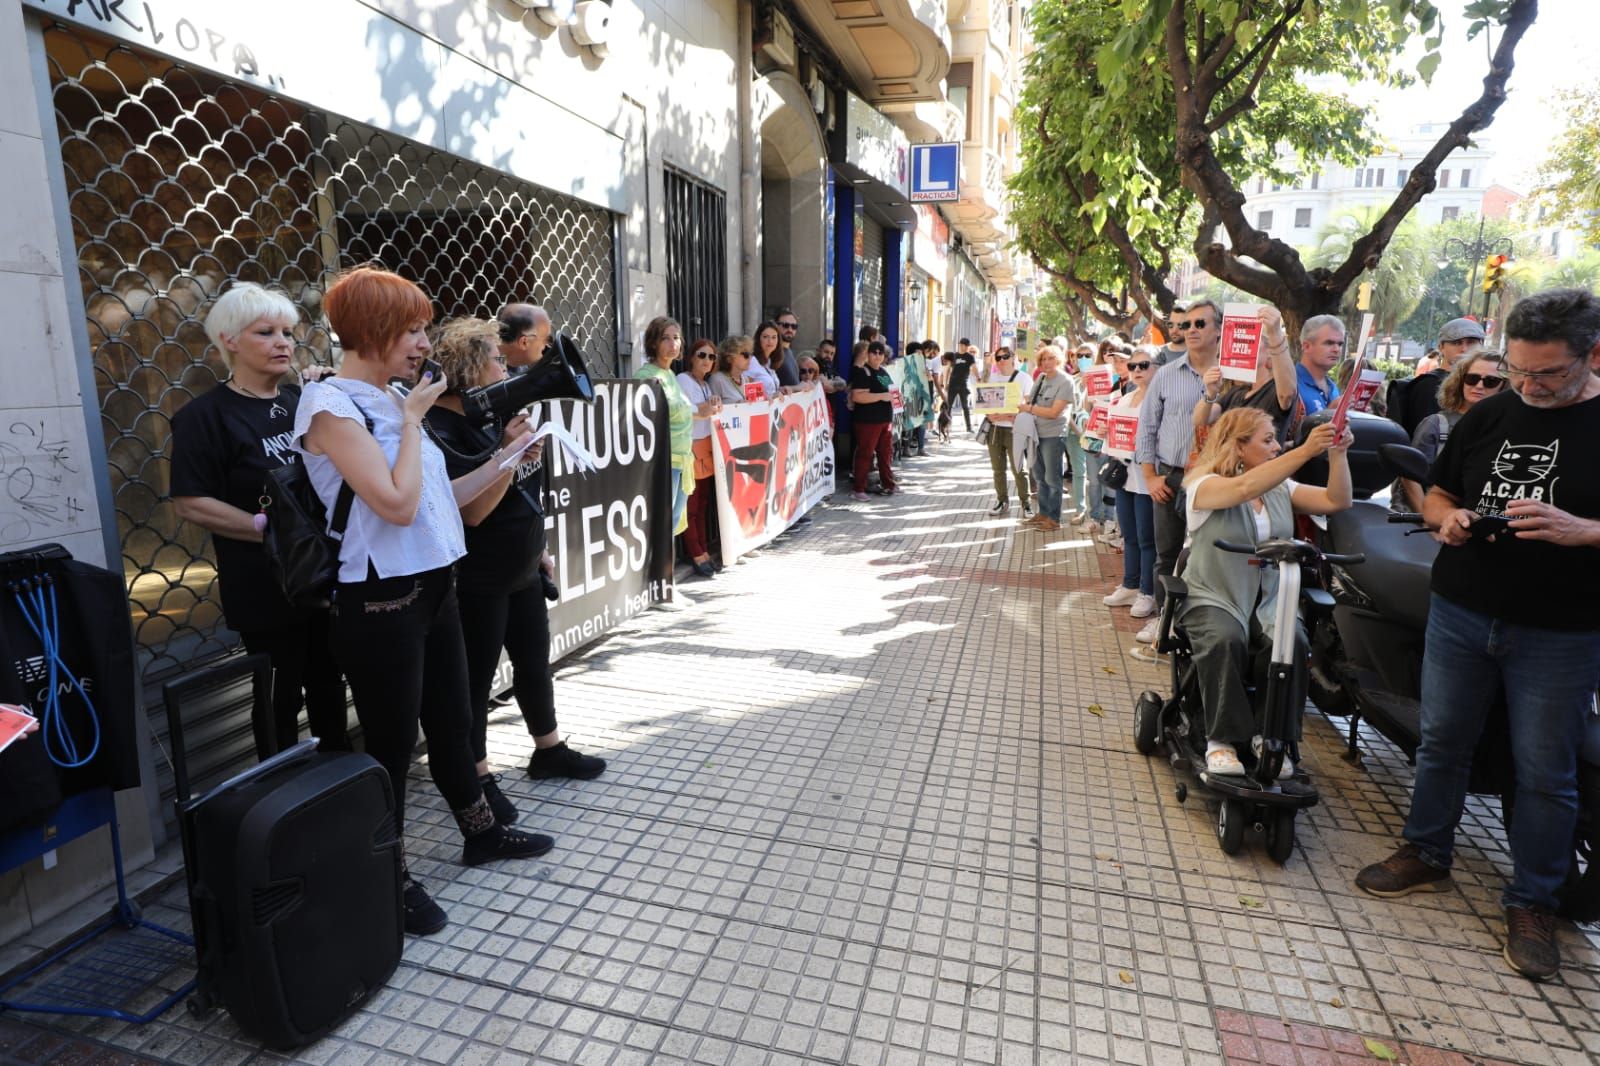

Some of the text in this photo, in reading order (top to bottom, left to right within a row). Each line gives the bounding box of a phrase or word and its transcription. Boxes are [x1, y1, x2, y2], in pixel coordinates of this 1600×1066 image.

[920, 148, 950, 190] L
[912, 191, 956, 200] PRACTICAS
[1477, 497, 1499, 508] ALL
[625, 579, 674, 617] health
